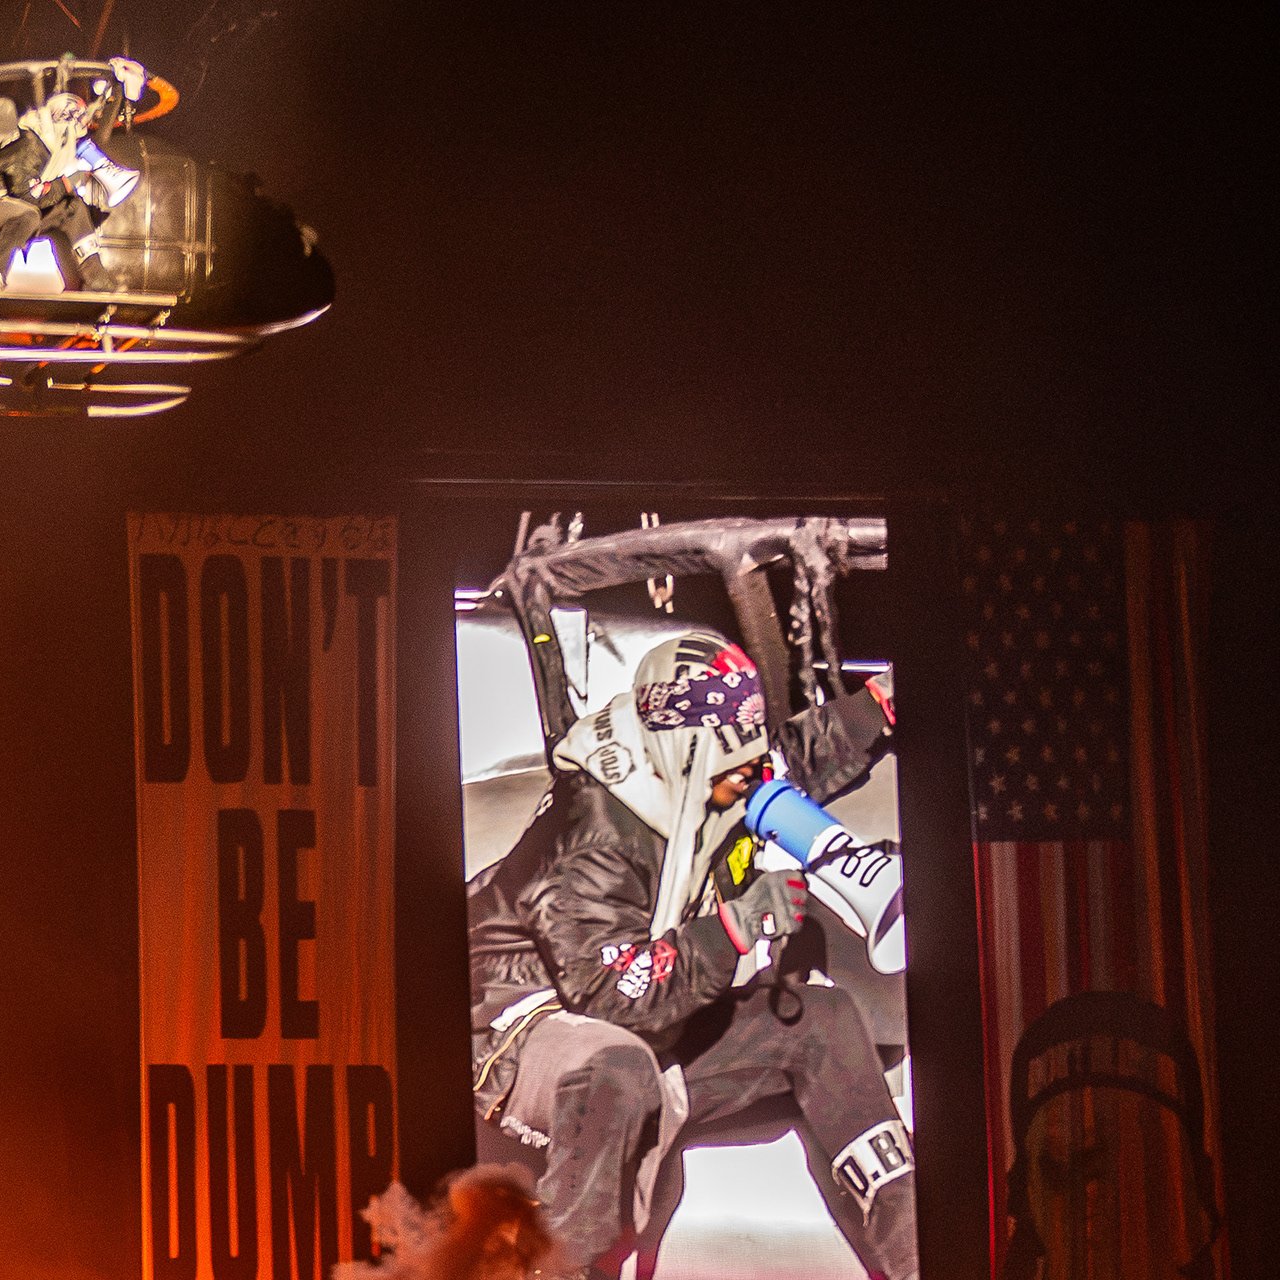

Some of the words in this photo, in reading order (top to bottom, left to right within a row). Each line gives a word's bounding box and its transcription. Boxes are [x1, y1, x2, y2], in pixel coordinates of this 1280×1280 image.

[139, 553, 391, 787] DON'T
[599, 746, 622, 781] STOP
[217, 808, 320, 1040] BE
